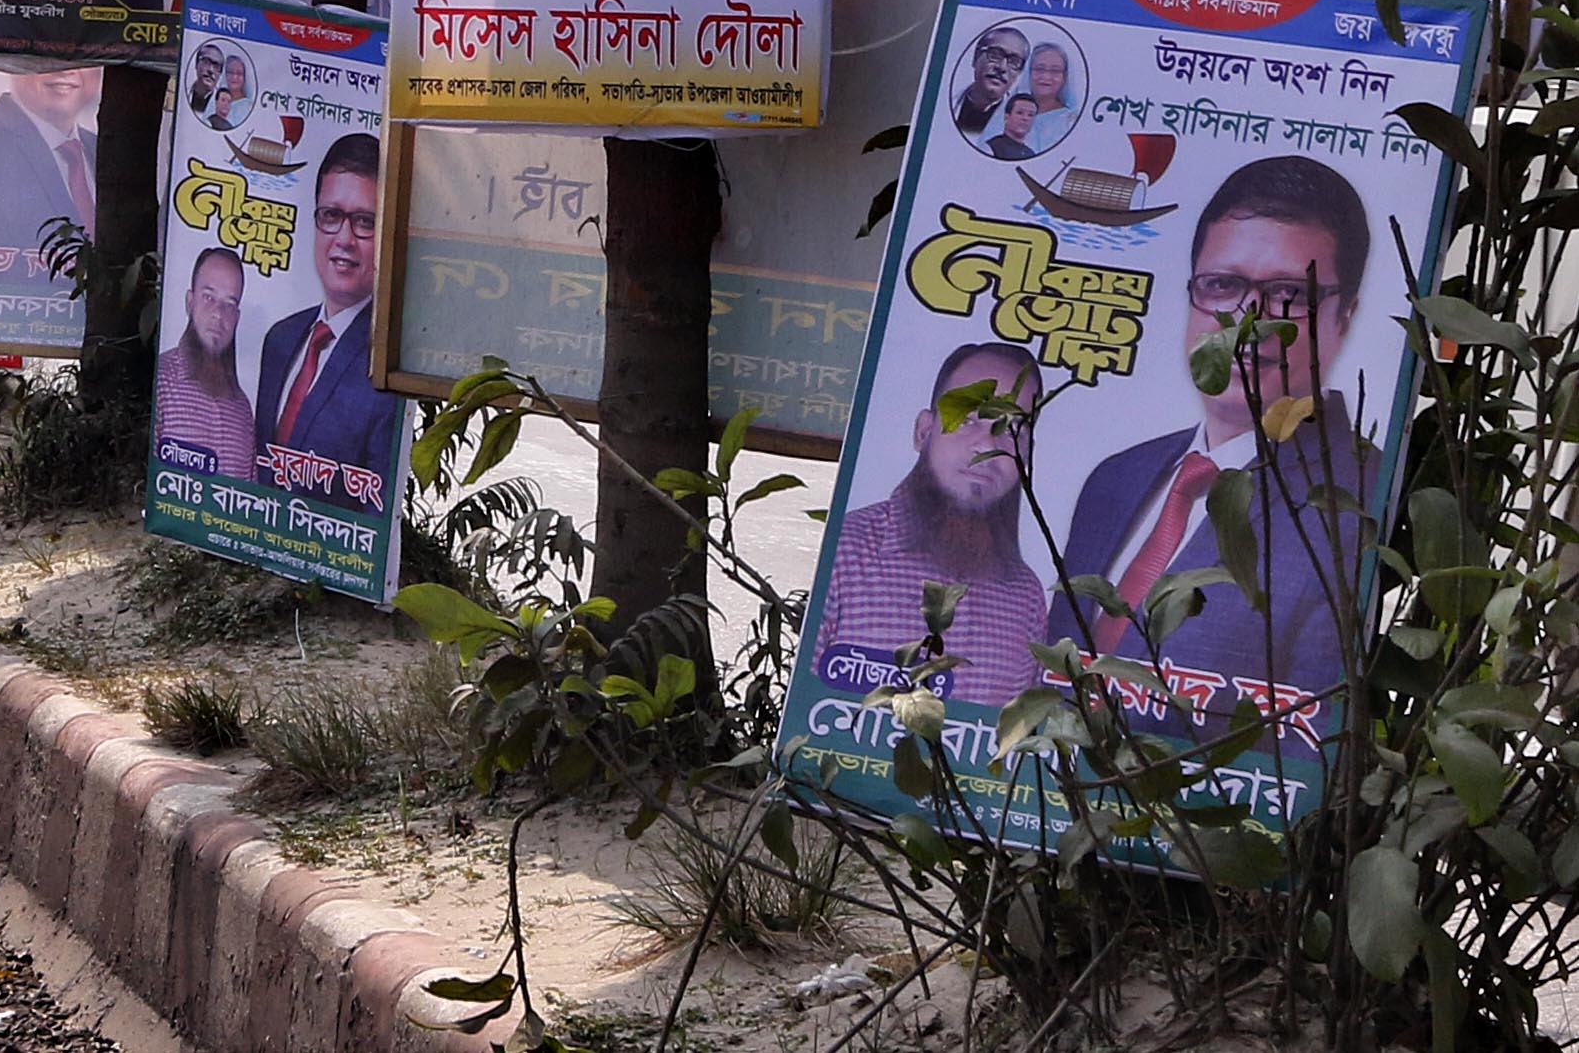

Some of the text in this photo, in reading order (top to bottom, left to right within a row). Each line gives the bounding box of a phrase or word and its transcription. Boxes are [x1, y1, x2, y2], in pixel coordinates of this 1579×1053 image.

[123, 21, 168, 44] মোঃ
[189, 8, 248, 34] জয় বাংলা
[1334, 11, 1373, 41] জয়
[289, 53, 380, 95] উন্নয়নে অংশ
[409, 77, 444, 97] সাবেক
[519, 79, 547, 101] জেলা
[687, 82, 732, 104] উপজেলা
[1154, 37, 1395, 102] উন্নয়নে অংশ নিন
[260, 89, 354, 124] শেখ হাসিনার
[1091, 94, 1431, 166] শেখ হাসিনার সালাম নিন
[174, 157, 297, 231] নৌকায়
[219, 214, 296, 250] ভোট
[241, 238, 291, 278] দিন
[907, 203, 1155, 317] নৌকায়
[991, 287, 1150, 346] ভোট
[1039, 329, 1138, 387] দিন
[342, 463, 384, 513] জং
[156, 470, 378, 554] মোঃ বাদশা সিকদার
[156, 501, 197, 523] সাভার
[200, 508, 259, 540] উপজেলা
